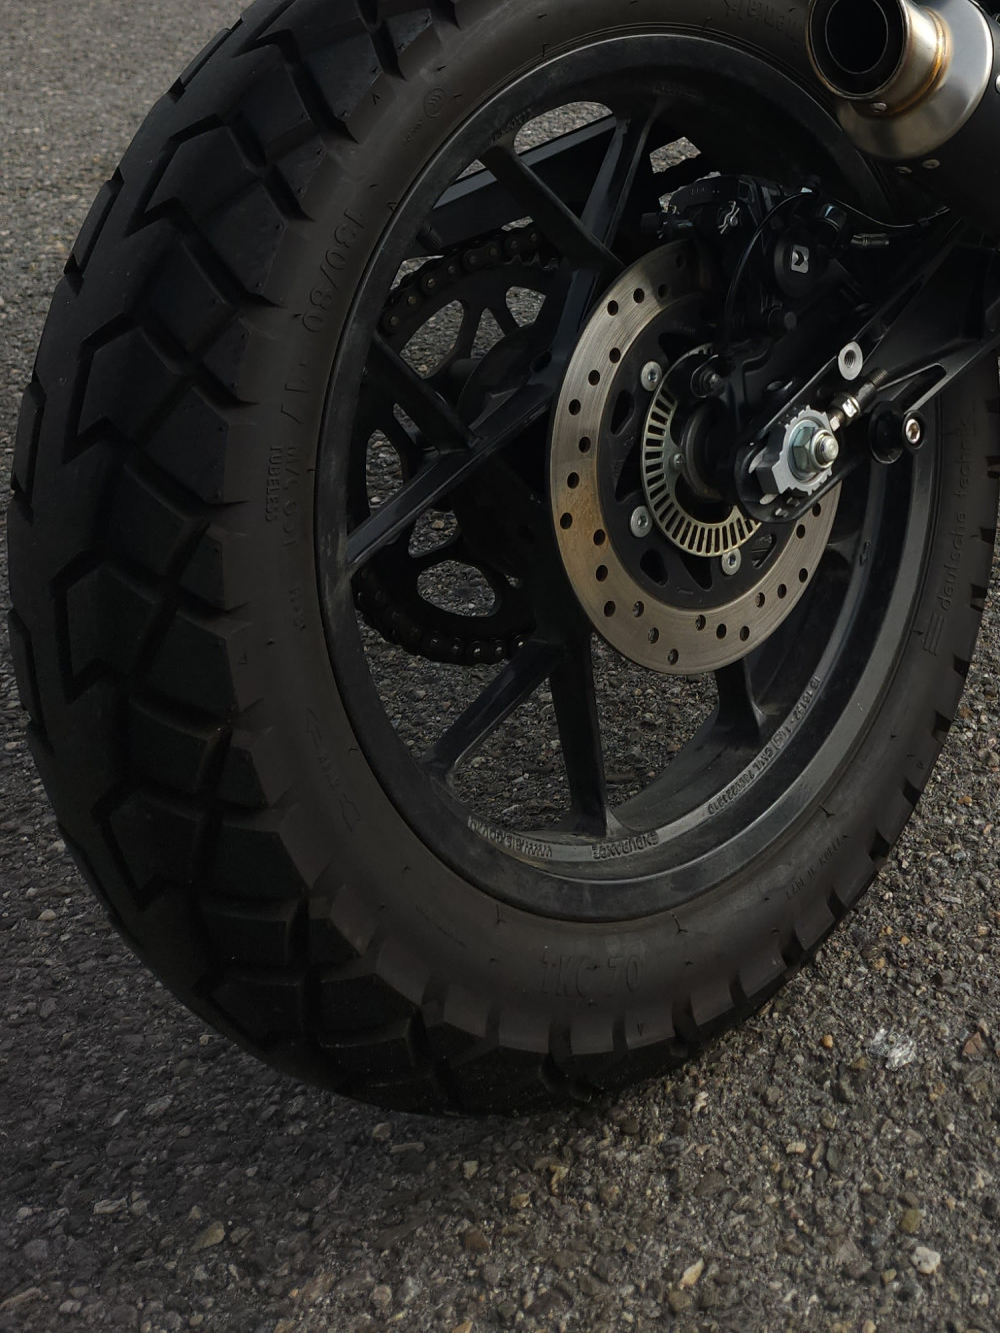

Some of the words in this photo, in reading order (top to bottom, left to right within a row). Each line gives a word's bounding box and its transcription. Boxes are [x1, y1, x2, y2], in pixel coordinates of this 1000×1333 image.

[302, 208, 367, 333] 130/80
[266, 445, 282, 523] TUBELESS
[937, 513, 967, 612] deutsche
[592, 830, 660, 860] ENDURANCE
